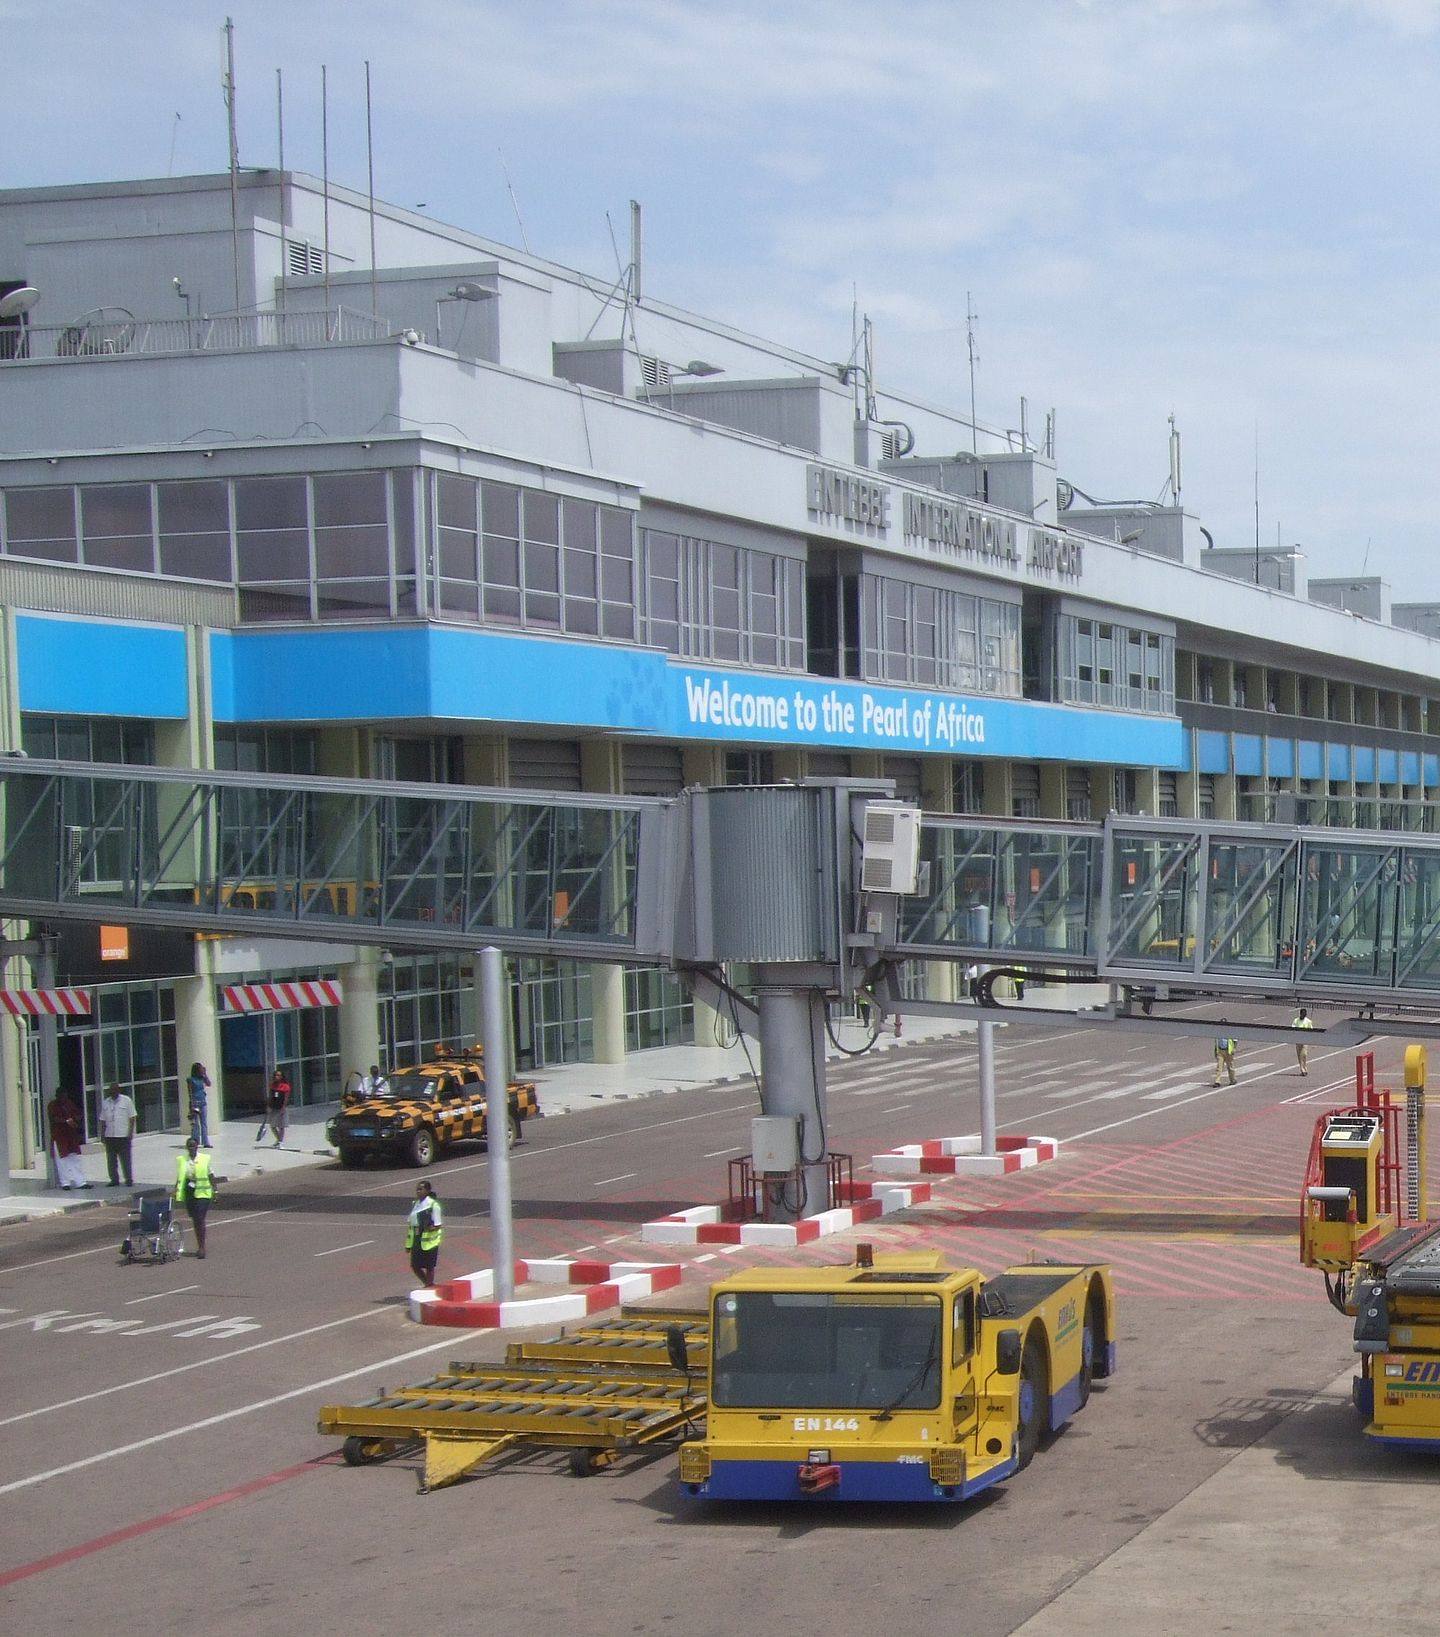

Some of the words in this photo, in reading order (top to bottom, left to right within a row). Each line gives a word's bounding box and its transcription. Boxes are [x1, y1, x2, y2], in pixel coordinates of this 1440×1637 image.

[806, 464, 891, 529] ENTEBBE
[902, 492, 1021, 562] INTERNATIONAL
[1026, 528, 1085, 577] AIRPORT
[685, 676, 788, 730] Welcome
[794, 691, 816, 732] to
[822, 690, 855, 733] the
[862, 693, 909, 738] Pearl
[913, 699, 932, 746] of
[936, 701, 985, 747] Africa
[794, 1418, 820, 1431] EN
[823, 1418, 858, 1431] 144
